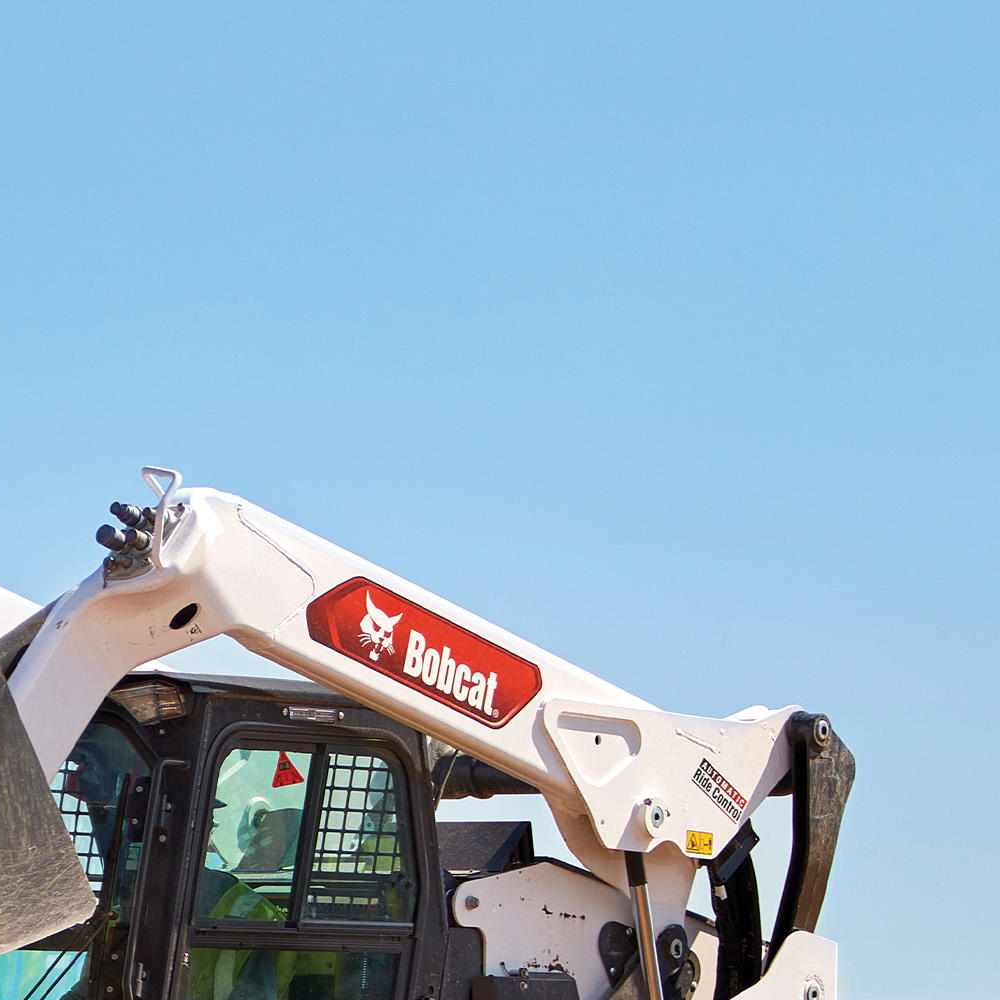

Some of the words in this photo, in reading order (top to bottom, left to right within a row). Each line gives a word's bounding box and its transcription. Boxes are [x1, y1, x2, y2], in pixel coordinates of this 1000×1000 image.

[403, 629, 498, 716] Bobcat
[693, 768, 712, 792] Ride
[711, 786, 742, 821] Control
[701, 760, 745, 808] AUTOMATIC
